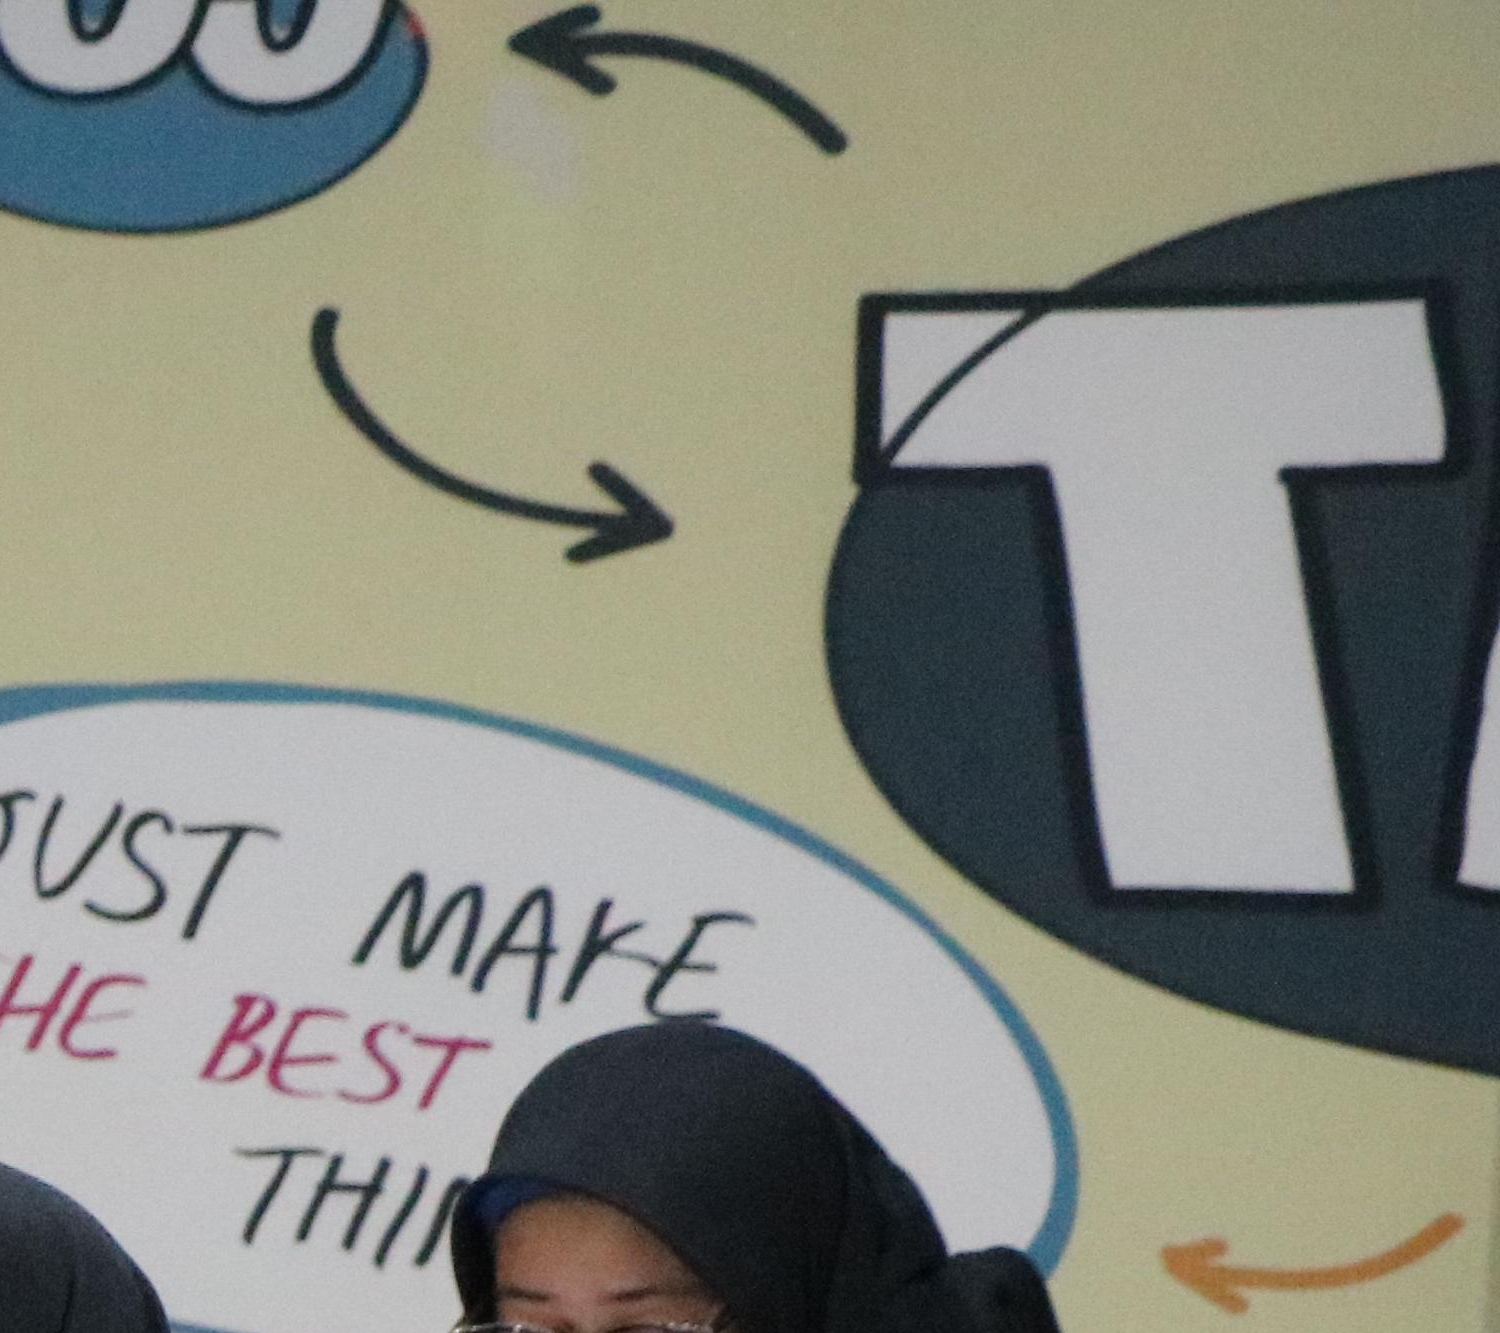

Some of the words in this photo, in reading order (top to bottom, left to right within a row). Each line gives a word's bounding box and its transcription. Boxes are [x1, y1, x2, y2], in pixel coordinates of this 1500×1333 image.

[855, 284, 1500, 908] T
[350, 869, 756, 1020] MAKE
[197, 992, 492, 1112] BEST
